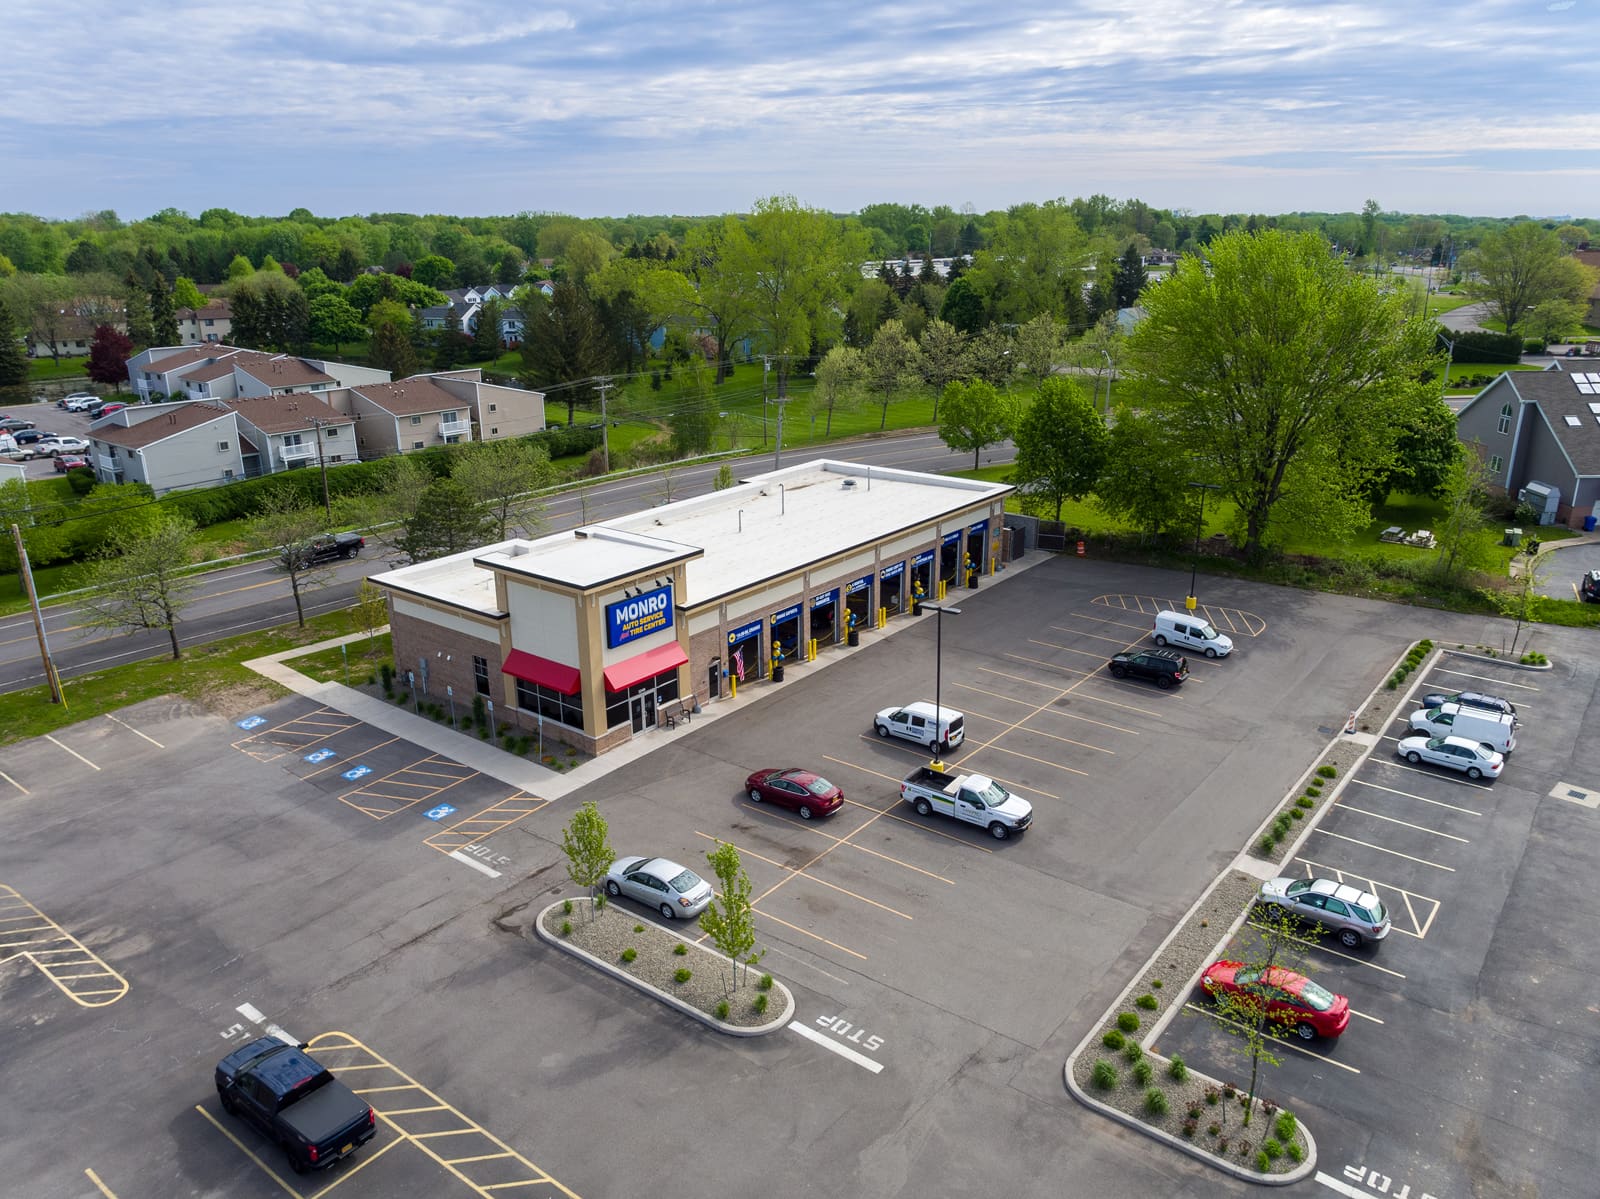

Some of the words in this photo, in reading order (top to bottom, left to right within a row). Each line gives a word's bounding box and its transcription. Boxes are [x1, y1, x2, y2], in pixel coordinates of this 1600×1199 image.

[616, 593, 667, 625] MONRO
[622, 619, 639, 631] AUTO
[639, 611, 664, 625] SERVICE
[629, 626, 644, 636] TIRE
[643, 618, 666, 631] CENTER
[815, 1015, 885, 1051] STOP
